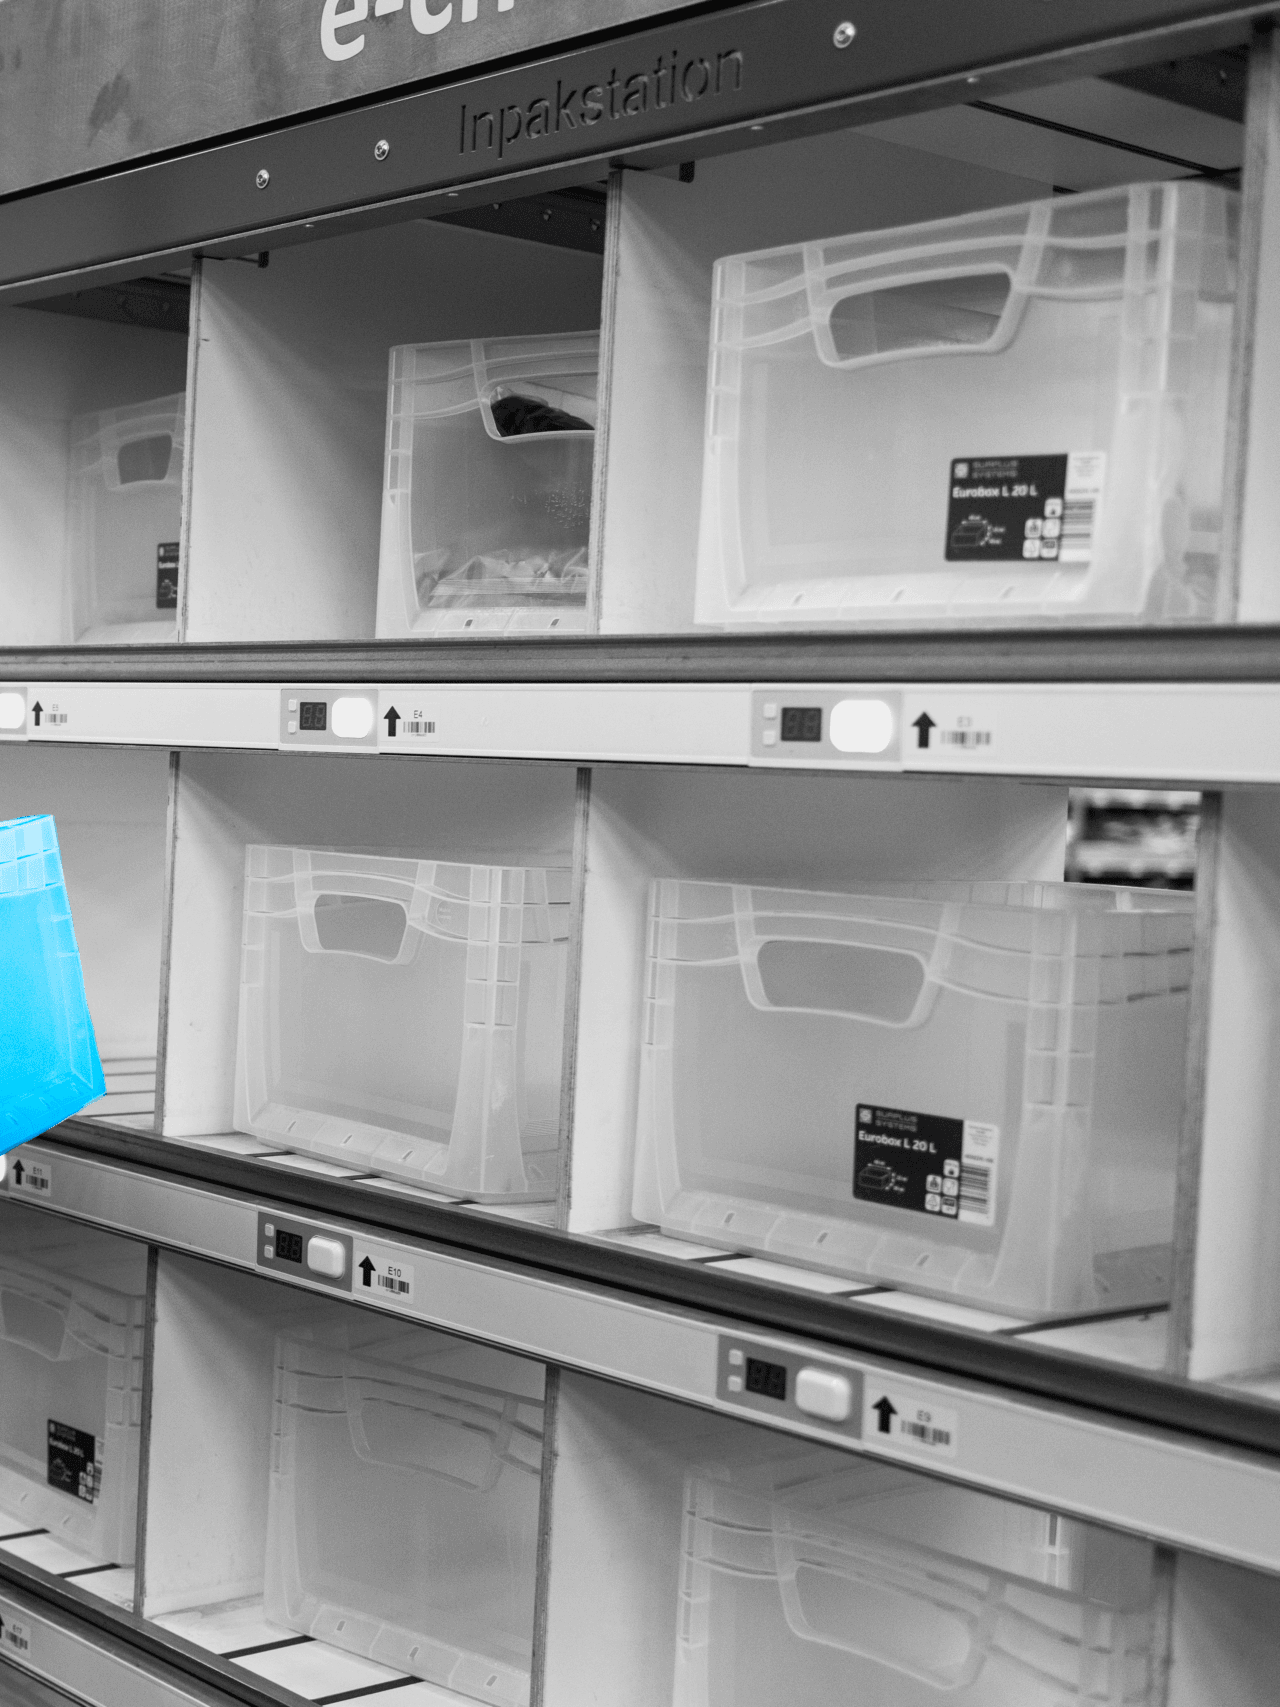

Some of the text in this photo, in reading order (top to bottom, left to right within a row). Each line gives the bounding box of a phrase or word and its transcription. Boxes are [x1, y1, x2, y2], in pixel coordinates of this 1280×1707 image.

[458, 49, 744, 160] Inpakstation
[952, 483, 1038, 498] Eurobox L 20 L
[413, 709, 424, 719] E4
[875, 1110, 918, 1122] SURPLUS
[875, 1119, 918, 1133] SYSTEMS
[858, 1130, 938, 1154] Eurobox L 20 L
[387, 1266, 402, 1277] E10
[916, 1409, 932, 1423] E9
